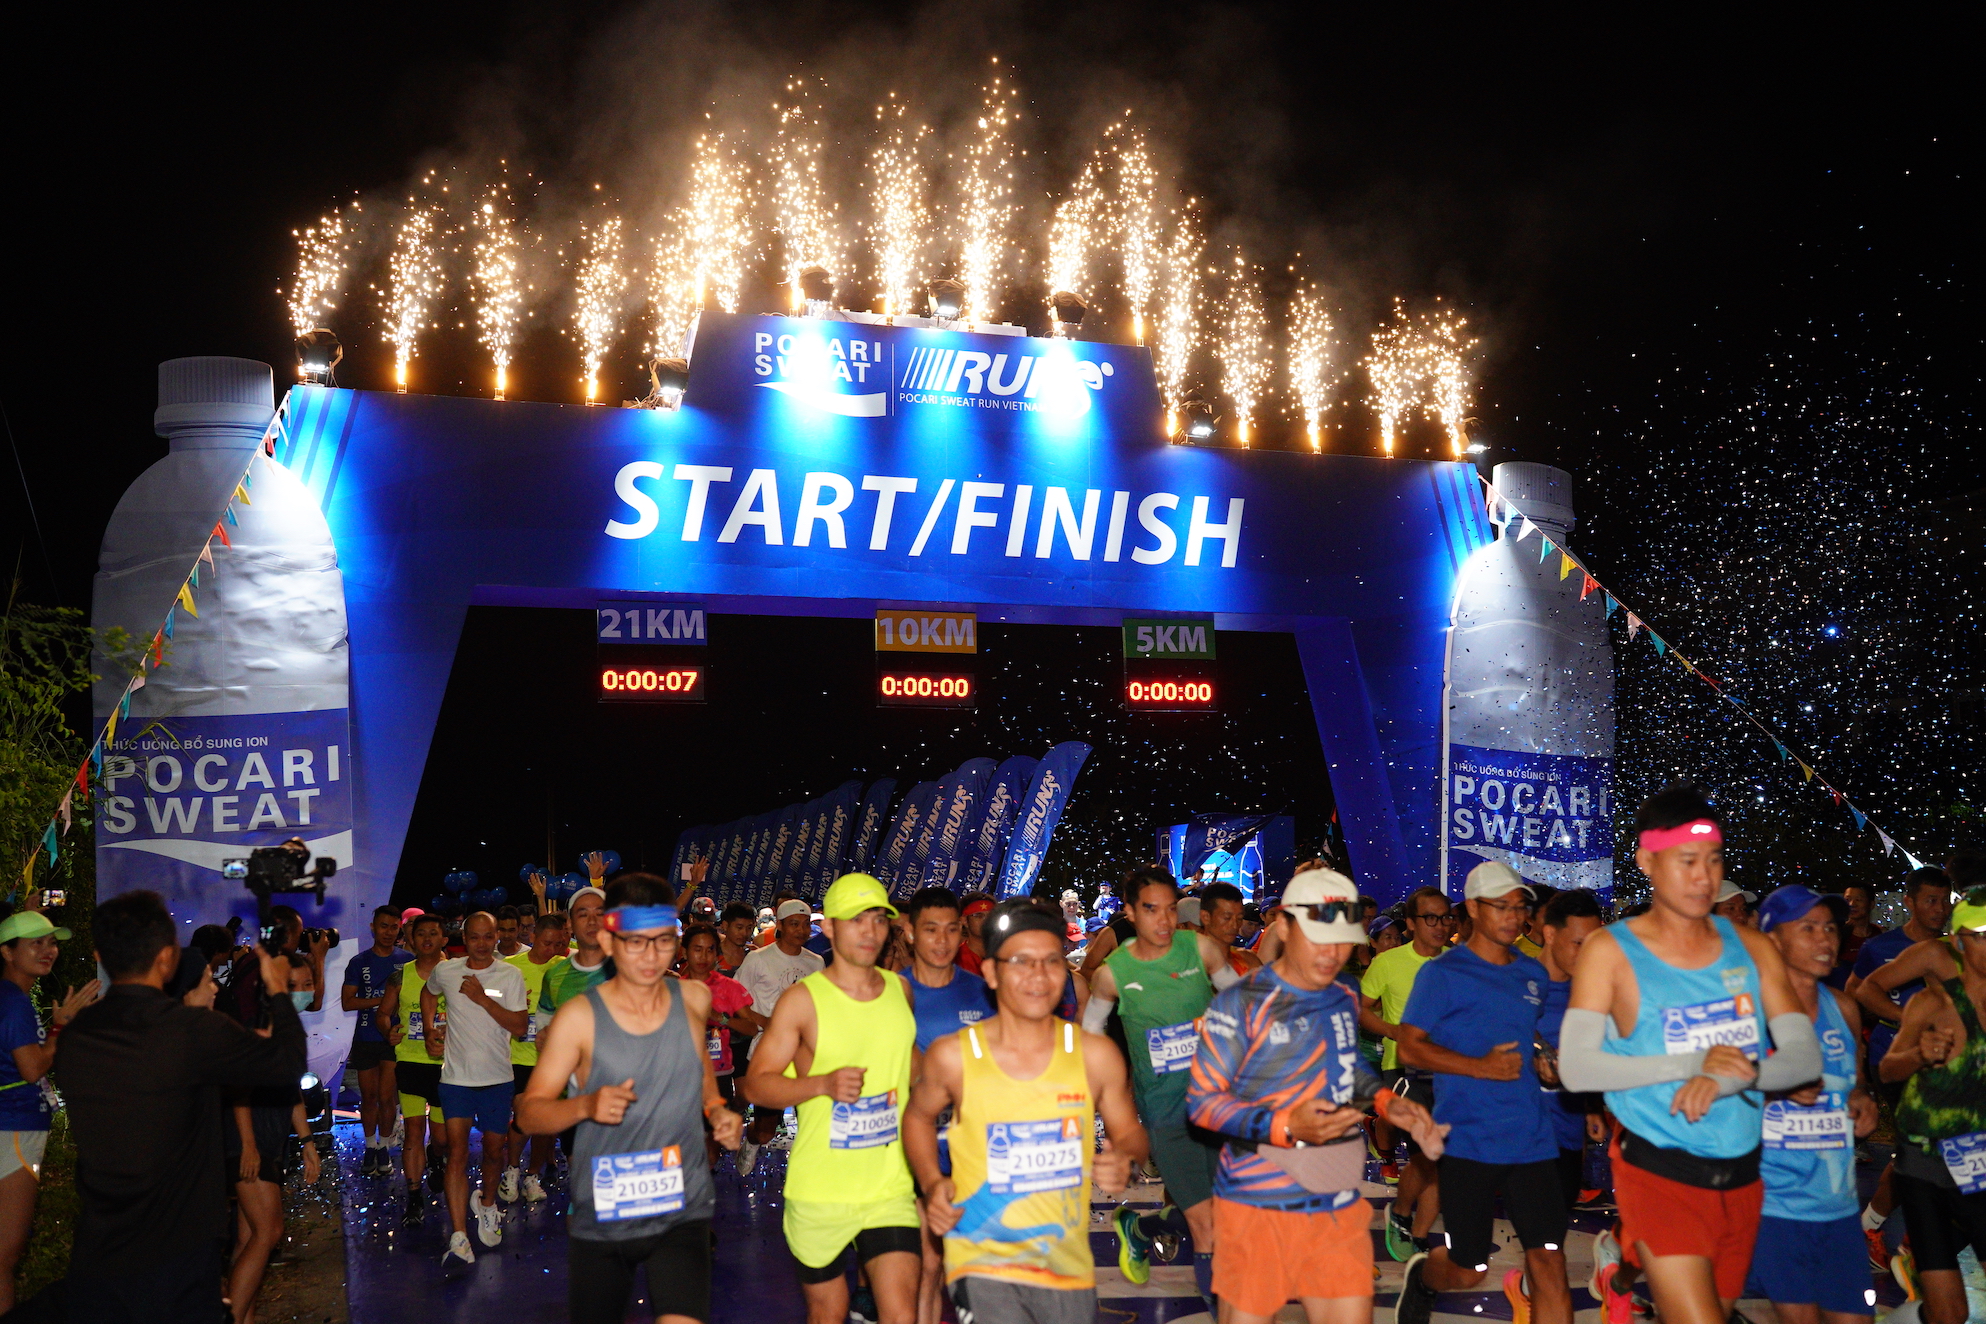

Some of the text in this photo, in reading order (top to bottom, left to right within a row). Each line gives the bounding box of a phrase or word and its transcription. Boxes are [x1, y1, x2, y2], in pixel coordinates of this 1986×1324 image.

[755, 332, 882, 363] POARI
[900, 392, 938, 405] POCARI
[940, 395, 976, 407] SWEAT
[978, 399, 1000, 409] RUN
[604, 460, 1246, 568] START/FINISH
[600, 609, 706, 640] 21KM
[879, 615, 976, 648] 10KM
[1135, 625, 1208, 654] 5KM
[602, 669, 699, 692] 0:00:07
[881, 676, 969, 698] 0:00:00
[1128, 681, 1213, 703] 0:00:00
[206, 737, 243, 749] SUNG
[246, 736, 269, 747] ION
[103, 745, 340, 794] POCARI
[1454, 775, 1608, 818] POCARI
[103, 788, 321, 834] SWEAT
[1453, 808, 1593, 849] SWEAT
[1740, 996, 1752, 1014] A
[1165, 1041, 1198, 1057] 2105
[850, 1112, 897, 1132] 210056
[1066, 1118, 1079, 1138] A
[1786, 1117, 1843, 1132] 211438
[666, 1148, 679, 1166] A
[1013, 1147, 1077, 1170] 210275
[618, 1174, 678, 1198] 210357
